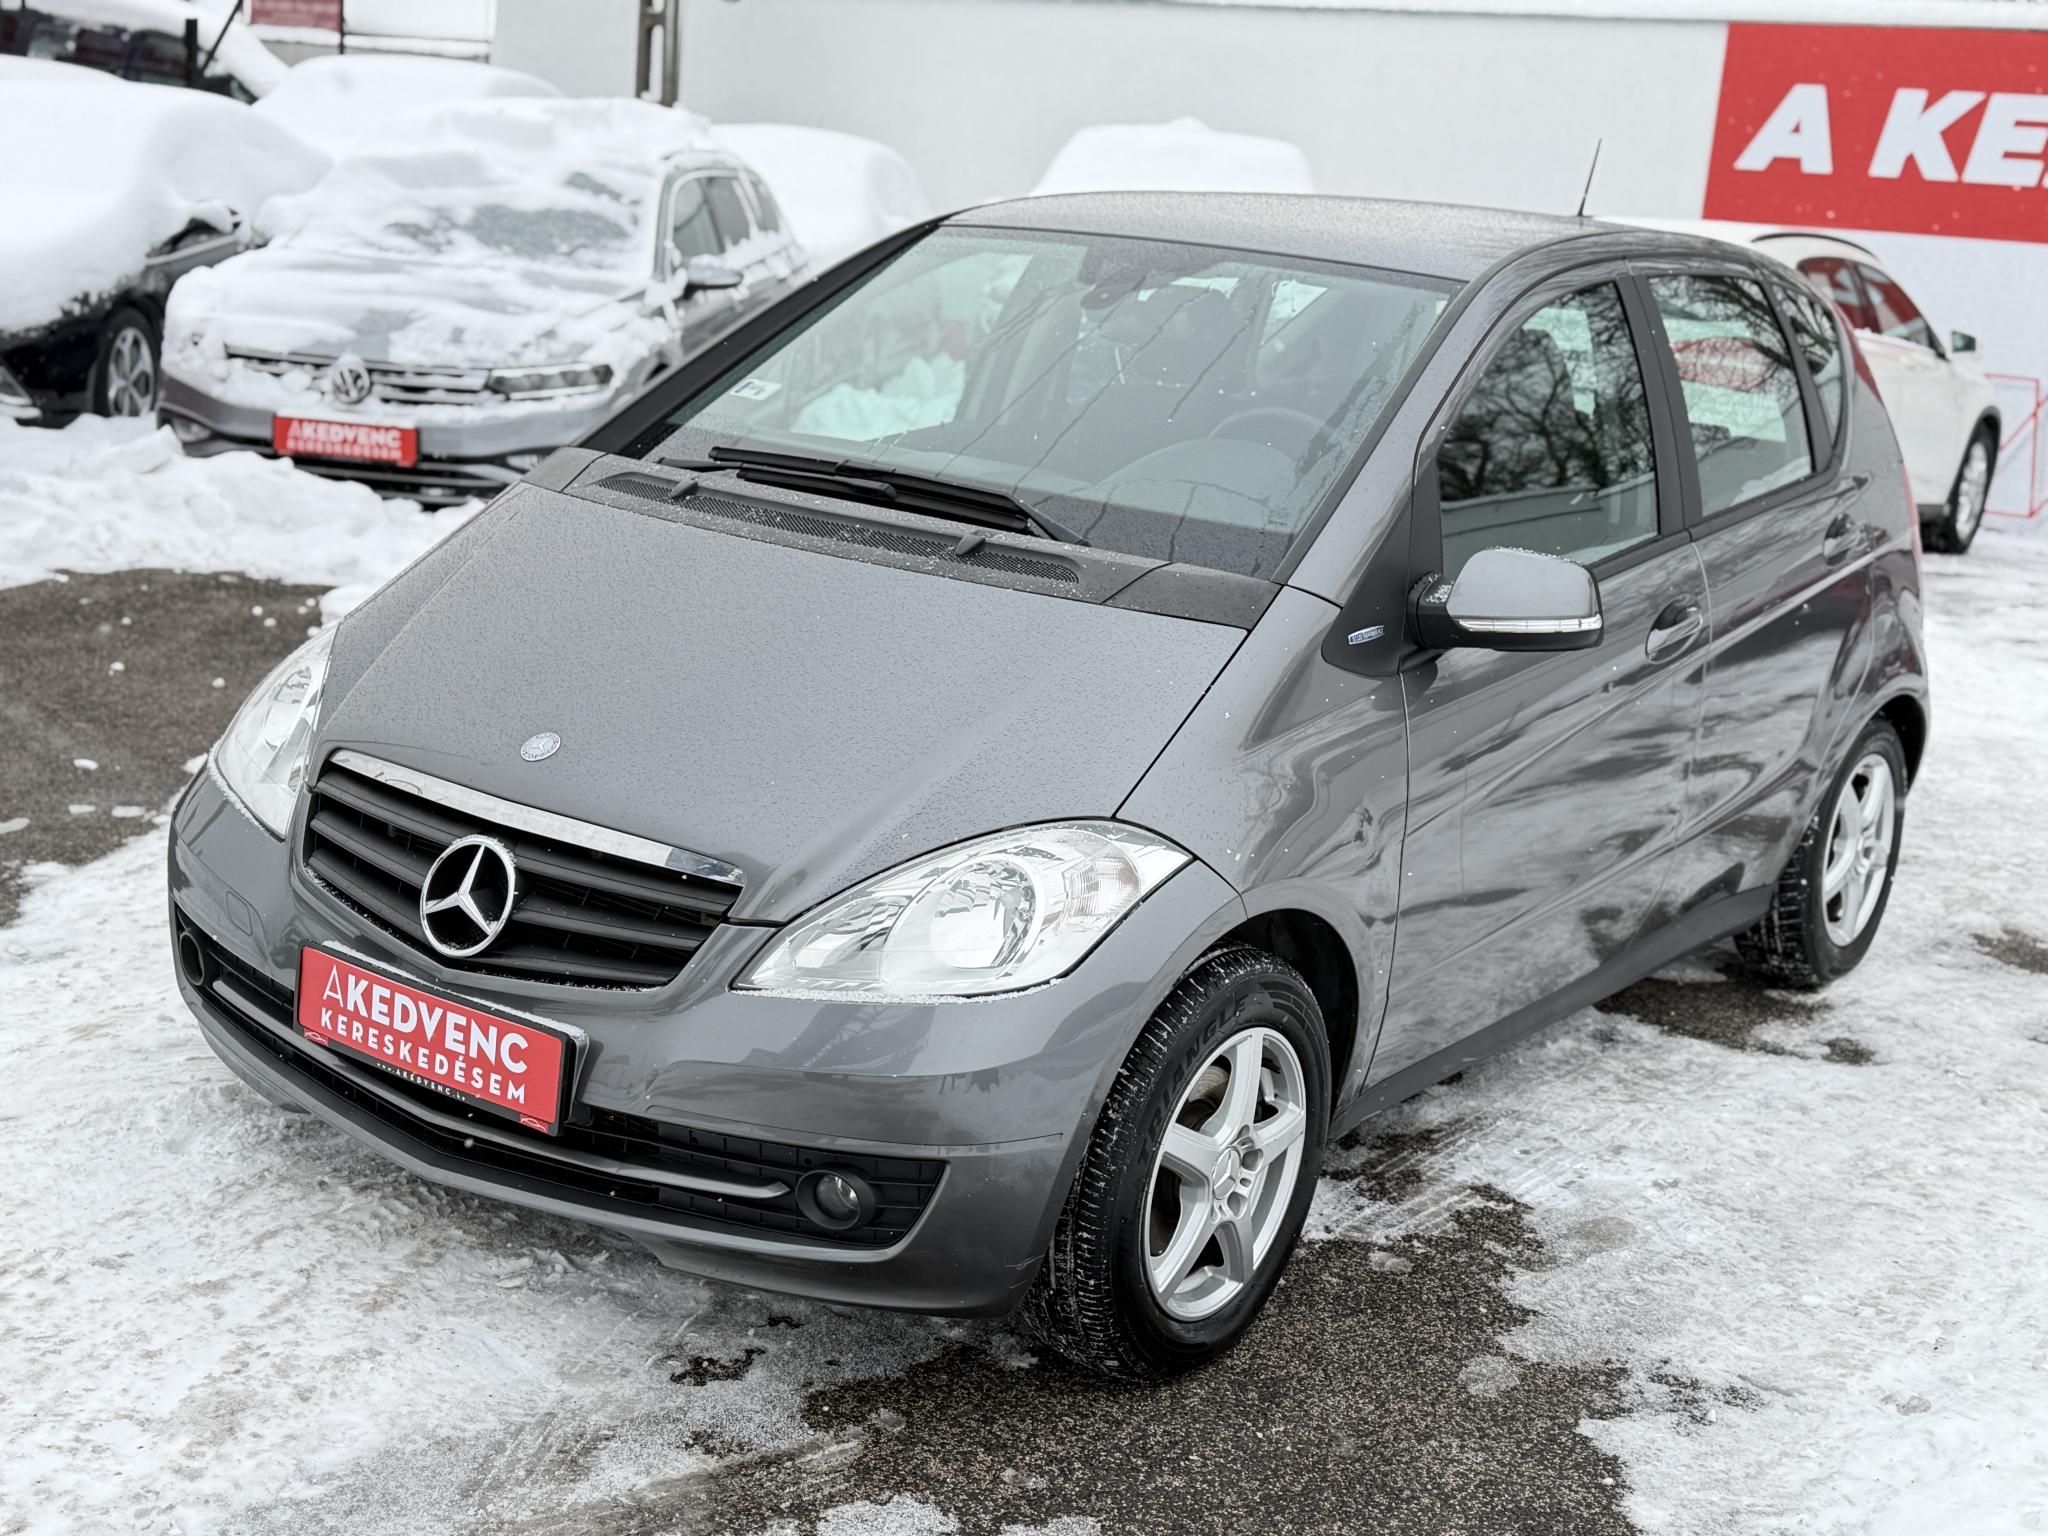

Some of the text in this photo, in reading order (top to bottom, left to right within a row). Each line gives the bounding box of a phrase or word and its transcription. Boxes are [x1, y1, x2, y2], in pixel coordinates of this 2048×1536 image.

[1732, 83, 2048, 189] A KE
[321, 1007, 526, 1105] KERESKEDÉSEM
[1137, 991, 1249, 1165] TRIANGLE
